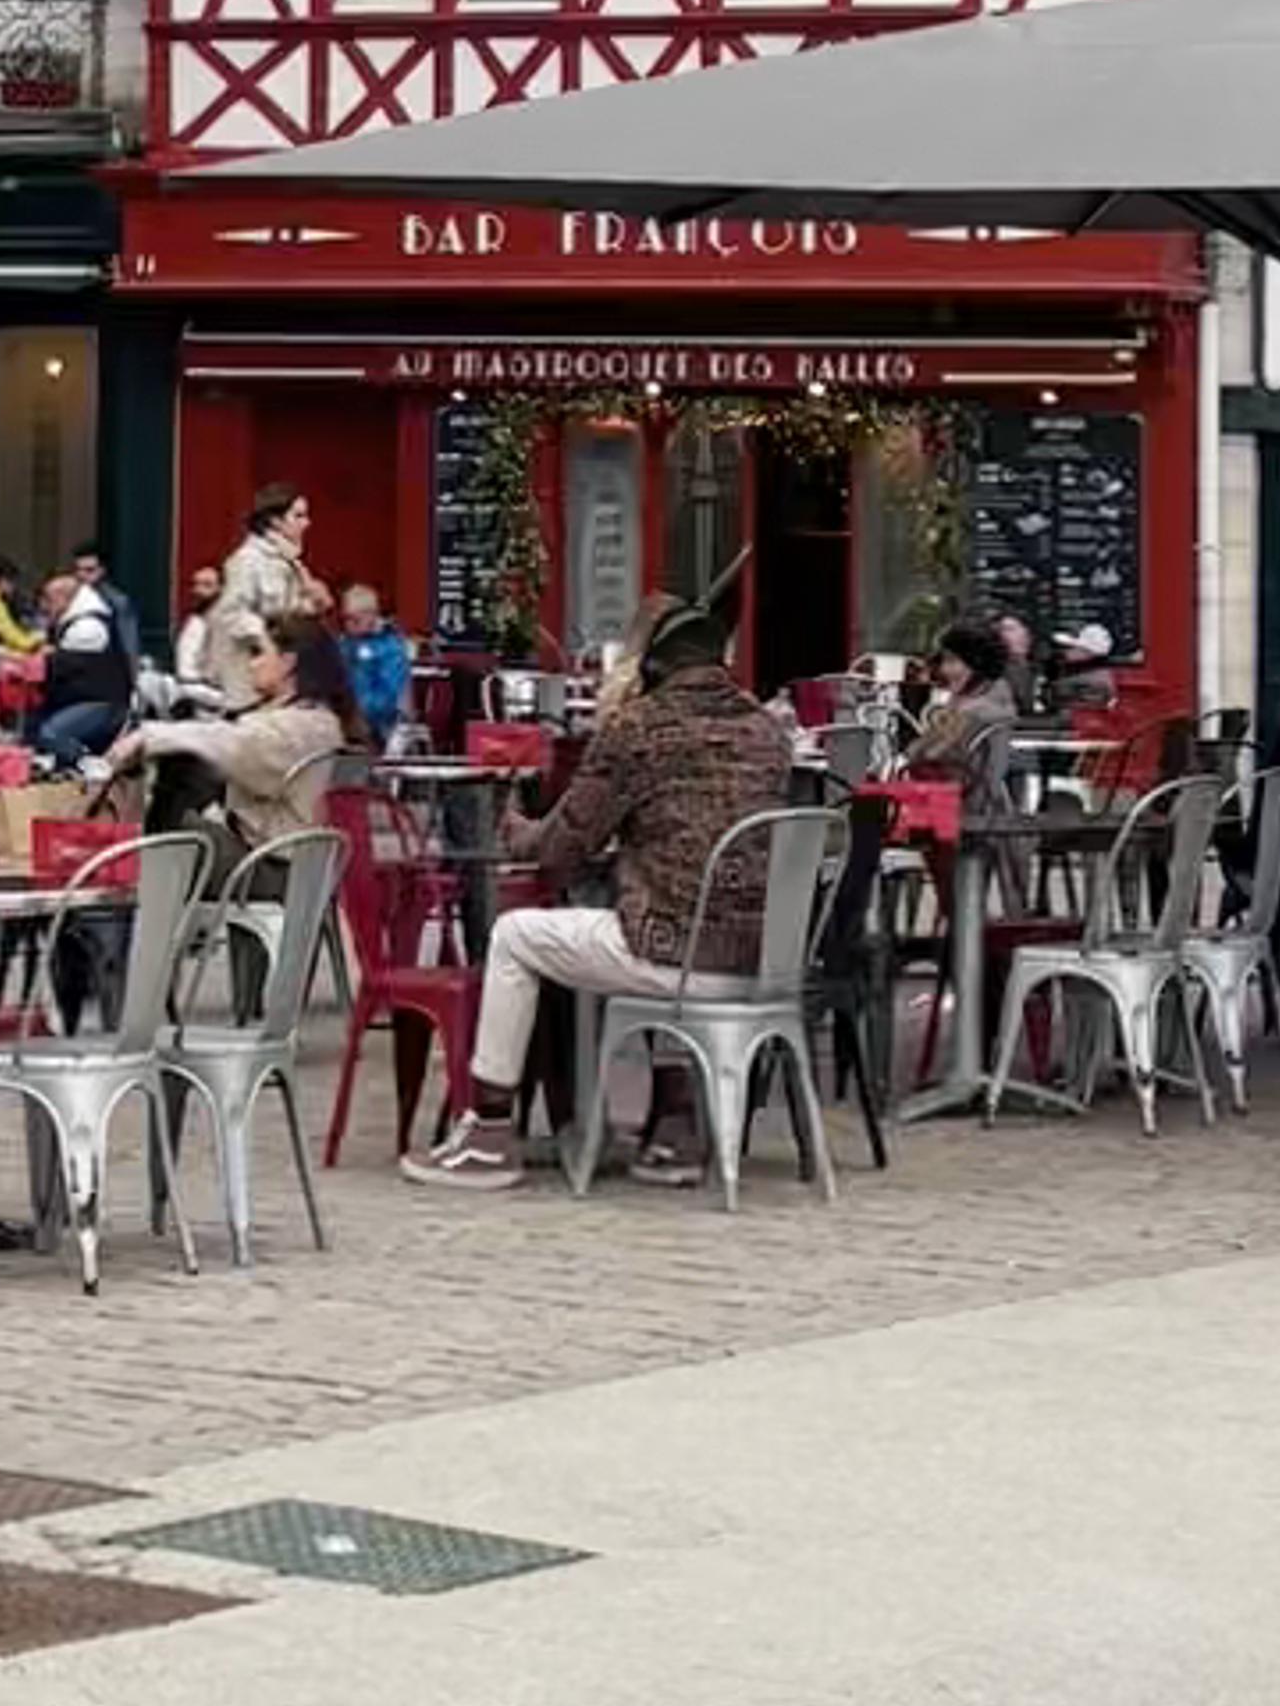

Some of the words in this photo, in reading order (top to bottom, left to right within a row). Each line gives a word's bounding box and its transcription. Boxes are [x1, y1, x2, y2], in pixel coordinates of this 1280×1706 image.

[402, 212, 507, 255] BAR
[394, 350, 433, 378] AU
[708, 351, 773, 382] DES
[796, 351, 915, 384] HALLES
